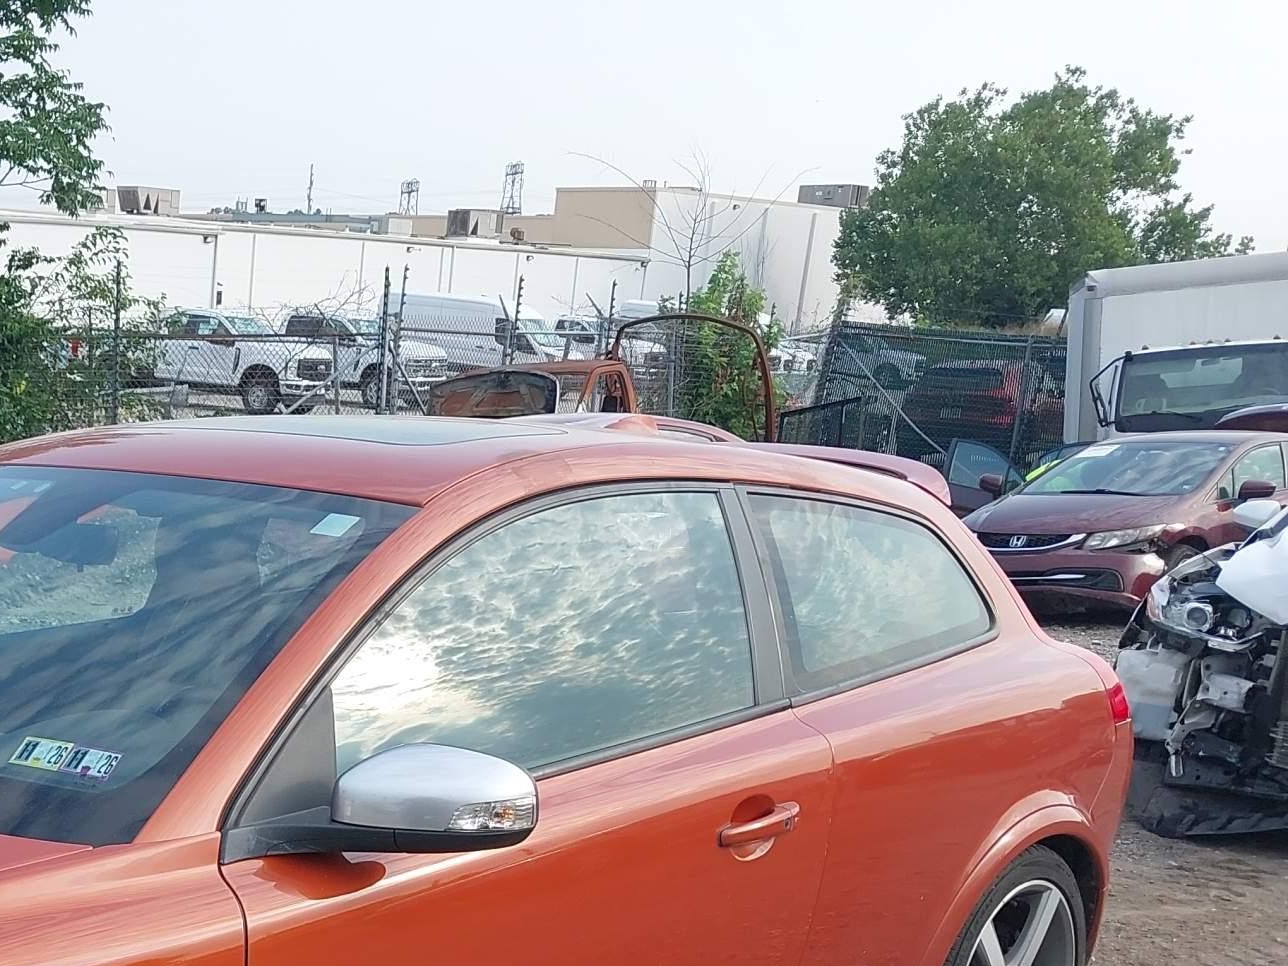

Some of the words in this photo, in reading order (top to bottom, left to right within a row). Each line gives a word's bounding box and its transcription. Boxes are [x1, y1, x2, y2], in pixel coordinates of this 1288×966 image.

[17, 741, 40, 761] 11
[47, 745, 69, 765] 26
[67, 749, 89, 770] 11
[97, 754, 119, 775] 26
